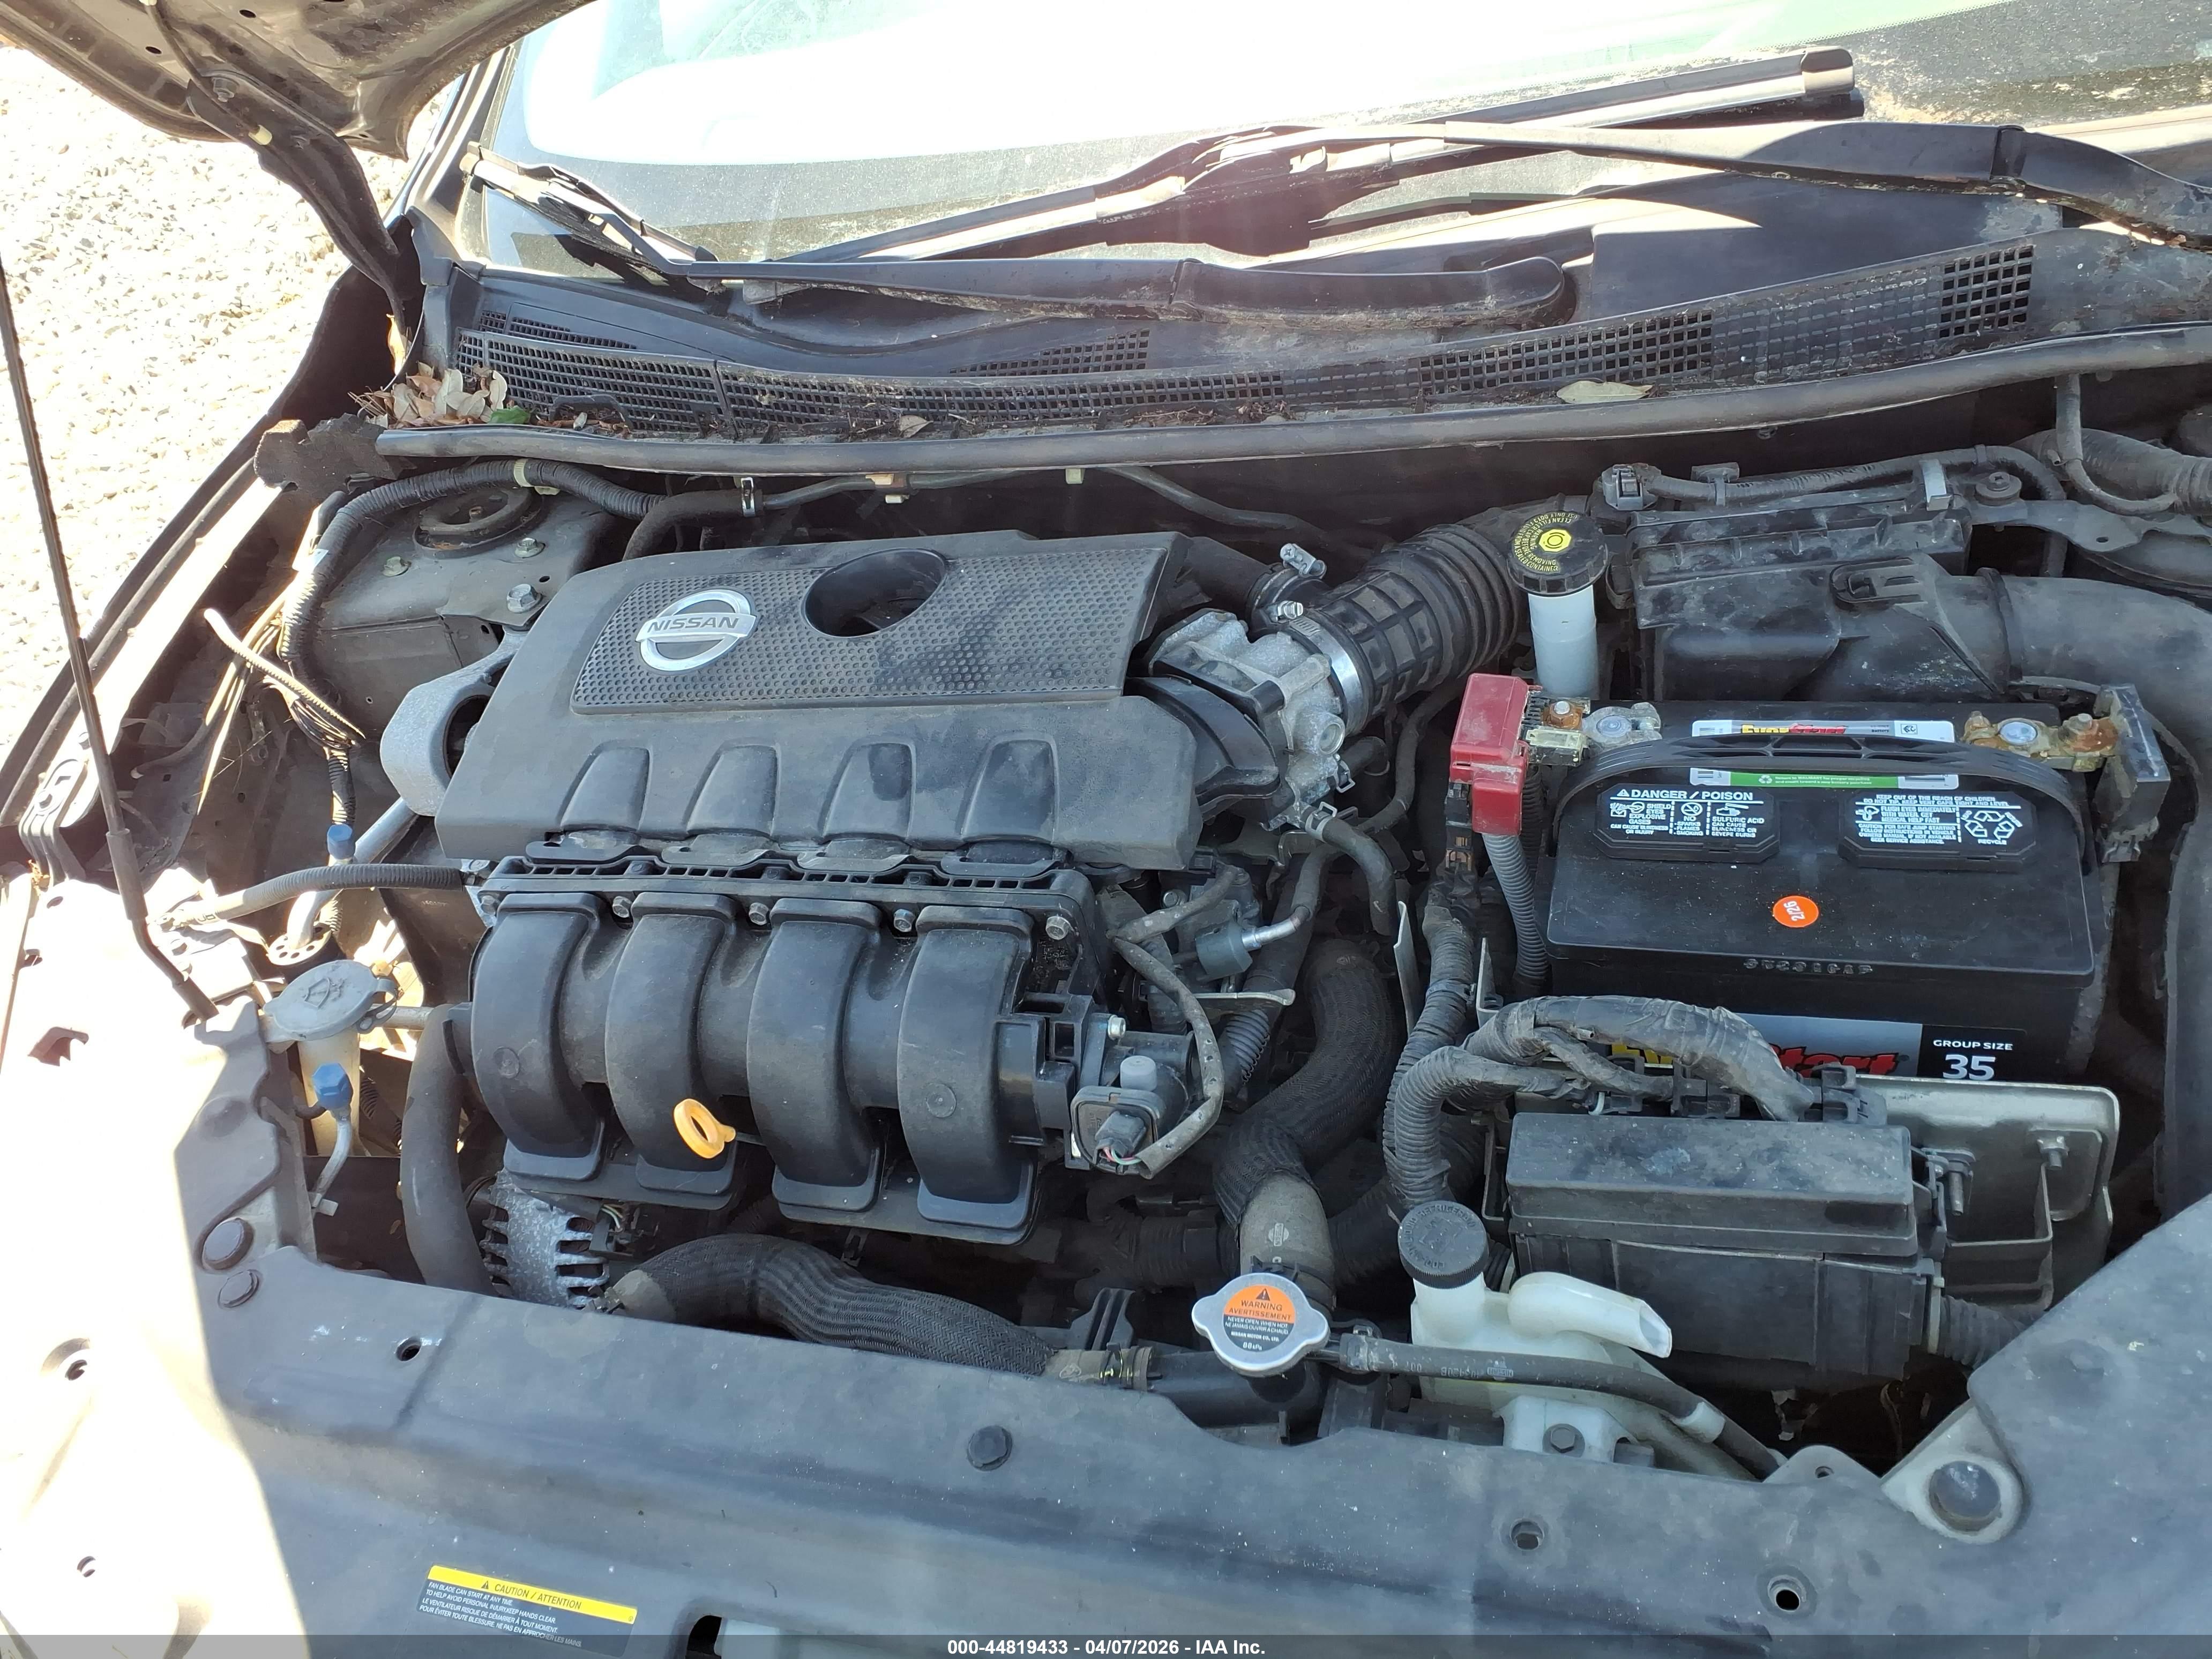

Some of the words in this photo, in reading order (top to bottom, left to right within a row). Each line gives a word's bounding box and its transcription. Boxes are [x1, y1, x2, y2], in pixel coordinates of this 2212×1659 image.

[1566, 513, 1578, 521] USE
[1520, 521, 1534, 533] FLUID
[1531, 519, 1551, 530] FILLER
[1514, 533, 1524, 545] FROM
[1525, 529, 1534, 538] CAP
[1529, 528, 1543, 550] WARNING
[1522, 539, 1531, 555] BEFORE
[1514, 549, 1529, 564] SEALED
[1527, 553, 1556, 565] REMOVING
[1526, 561, 1558, 572] CONTAINER
[647, 617, 738, 633] NISSAN
[1631, 789, 1687, 799] DANGER
[1702, 791, 1753, 801] POISON
[1783, 900, 1805, 921] 2/26
[1933, 1039, 1981, 1049] GROUP
[1983, 1042, 2013, 1050] SIZE
[1943, 1054, 1996, 1081] 35
[1241, 1299, 1282, 1312] WARNING
[1229, 1307, 1291, 1321] AVERTISSEMENT
[439, 1584, 455, 1593] BLADE
[467, 1590, 482, 1599] START
[495, 1584, 529, 1598] CAUTION
[537, 1593, 582, 1610] ATTENTION
[434, 1591, 447, 1599] HELP
[446, 1594, 462, 1603] AVOID
[462, 1597, 489, 1609] PERSONAL
[519, 1610, 539, 1620] HANDS
[430, 1599, 461, 1611] VENTILATEUR
[461, 1606, 480, 1616] RISQUE
[521, 1619, 535, 1628] TOUT
[419, 1605, 435, 1613] POUR
[435, 1607, 451, 1617] ÉVITER
[452, 1612, 468, 1621] TOUTE
[503, 1624, 513, 1632] PAS
[514, 1626, 522, 1634] EN
[522, 1628, 554, 1641] APPROCHER
[554, 1635, 564, 1643] LES
